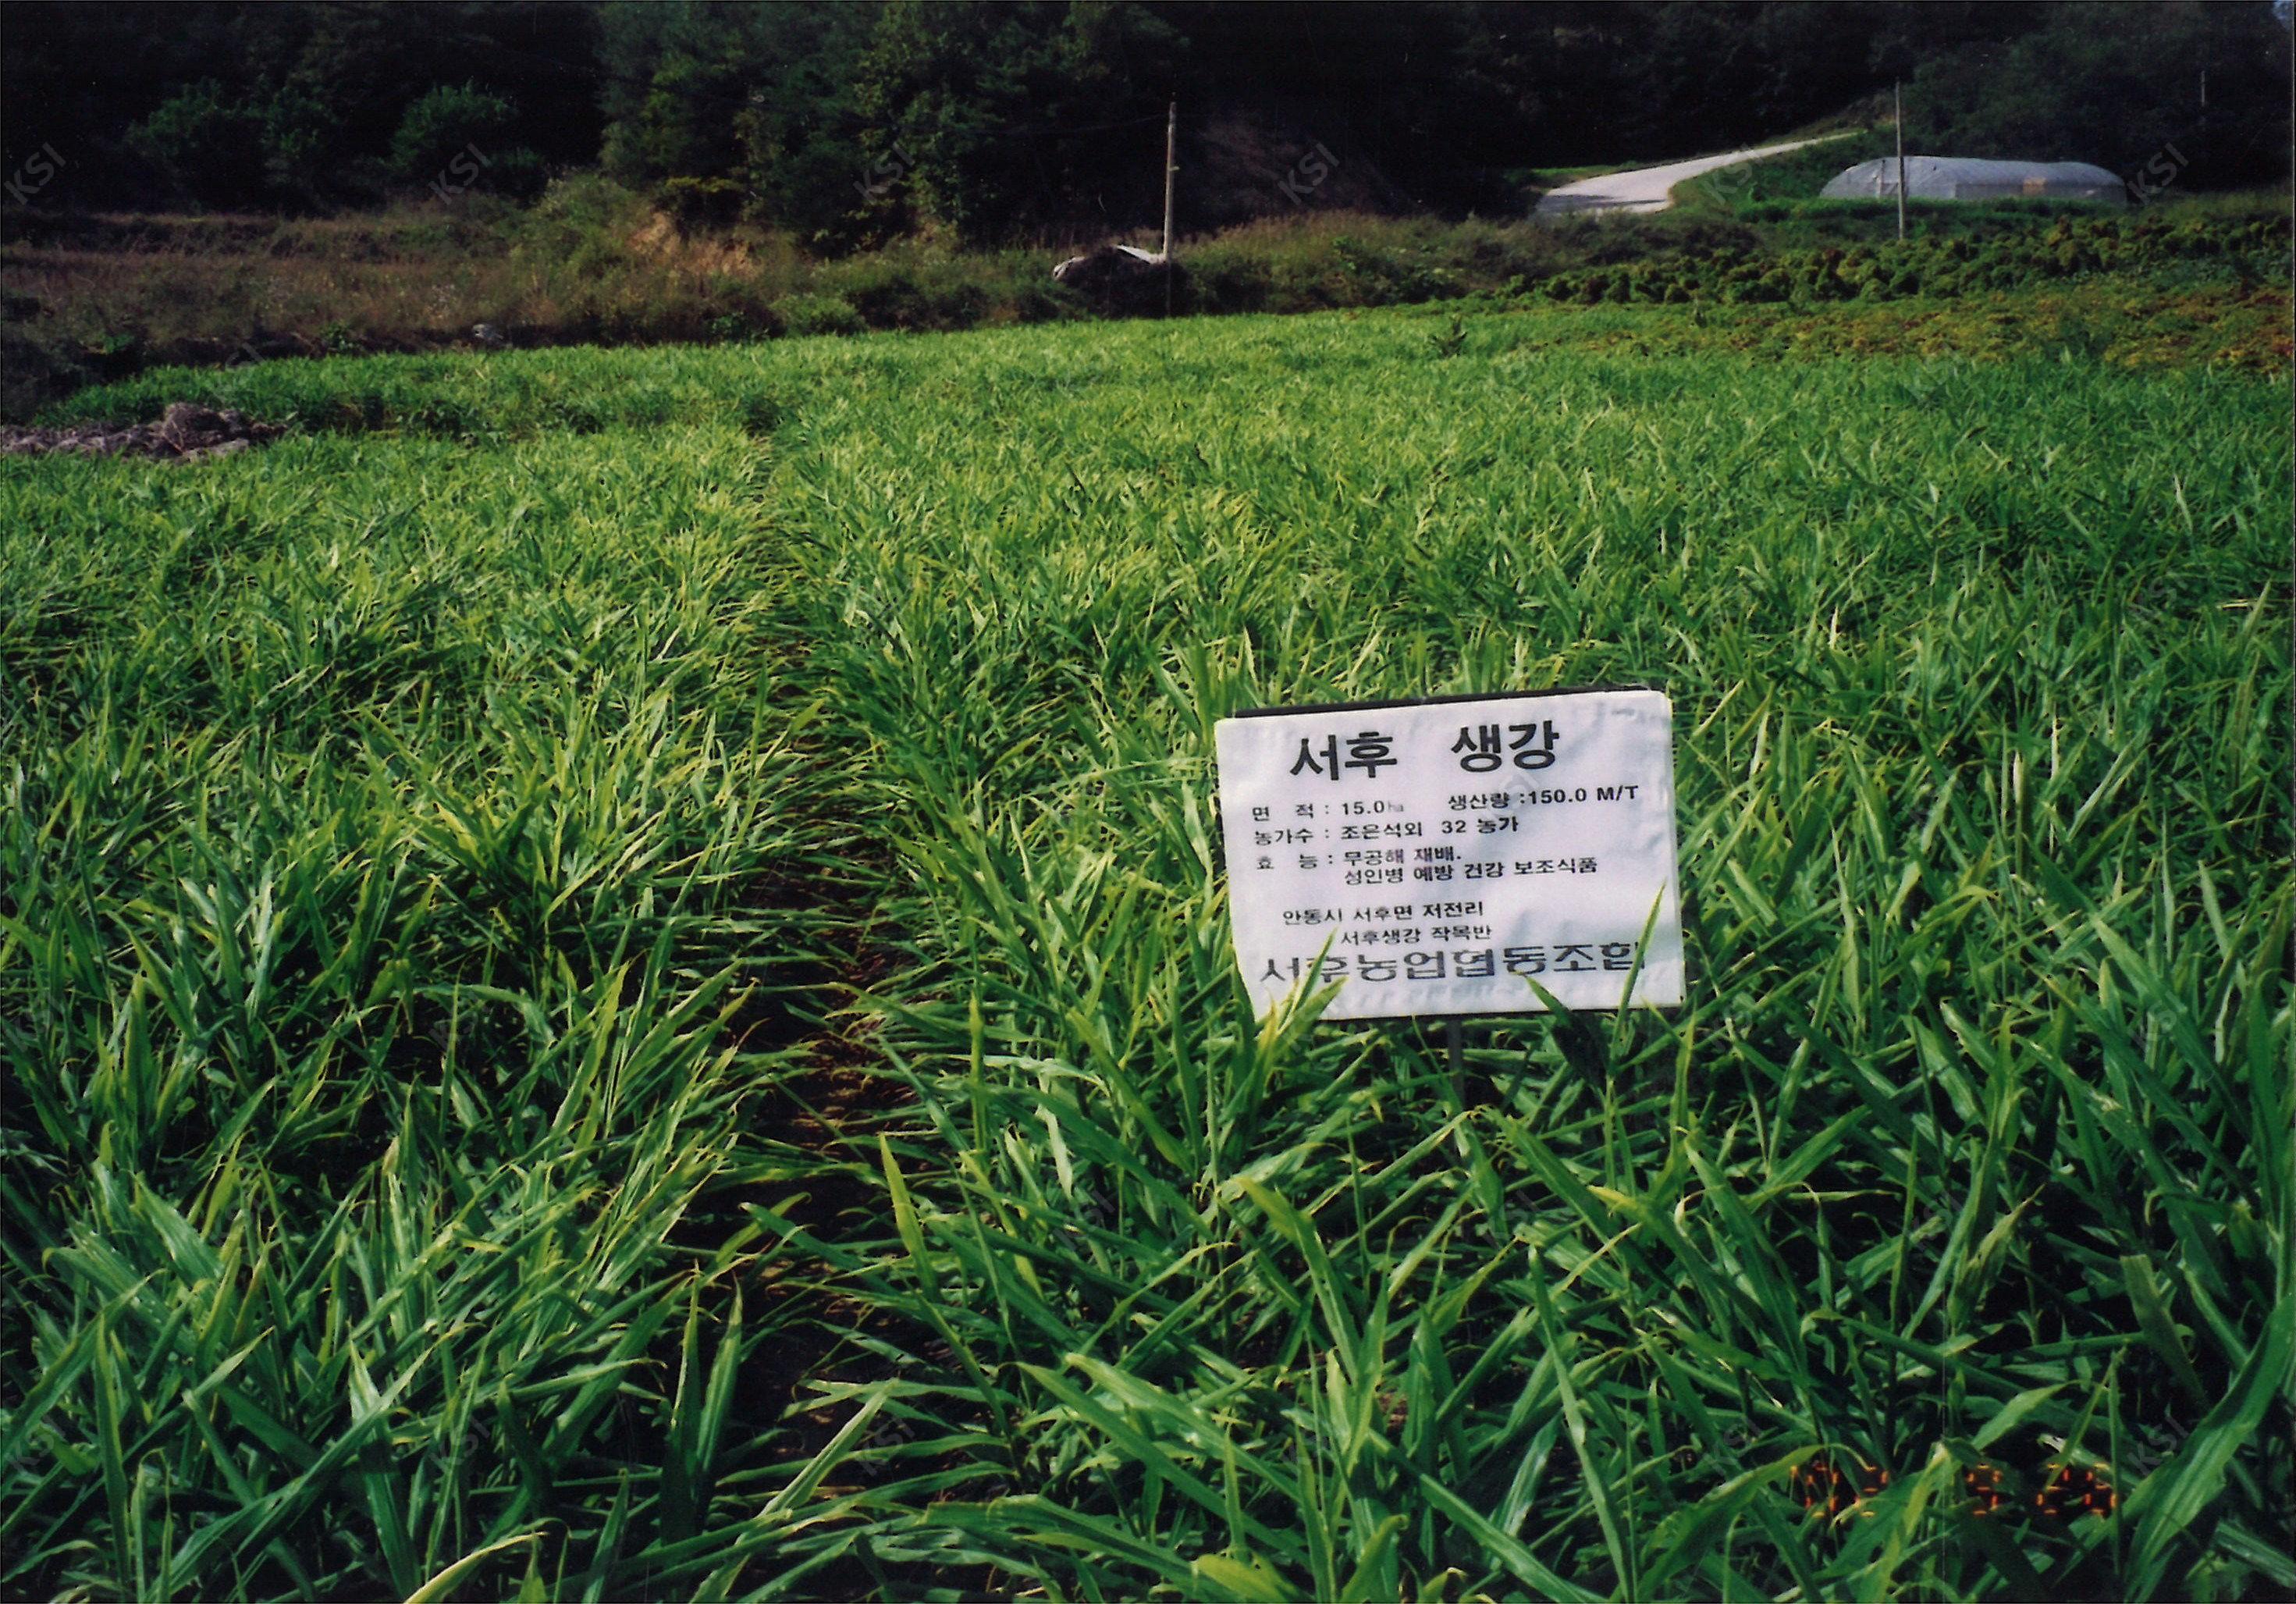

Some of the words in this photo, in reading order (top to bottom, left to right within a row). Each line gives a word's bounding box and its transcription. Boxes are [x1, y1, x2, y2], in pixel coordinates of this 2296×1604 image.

[1290, 731, 1398, 781] 서후
[1451, 720, 1560, 773] 생강
[1596, 784, 1639, 802] M/T
[1254, 827, 1314, 847] 농가수
[1341, 820, 1423, 841] 조은석외
[1441, 820, 1466, 834] 32
[1477, 816, 1519, 834] 농가
[1342, 848, 1404, 866] 무공해
[1345, 867, 1403, 886] 성인병
[1413, 864, 1455, 882] 예방
[1464, 861, 1505, 879] 건강
[1514, 856, 1598, 875] 보조식품
[1282, 908, 1342, 926] 안동시
[1353, 905, 1413, 922] 서후면
[1423, 901, 1483, 919] 저전리
[1341, 927, 1421, 945] 서후생강
[1431, 924, 1492, 942] 작목반
